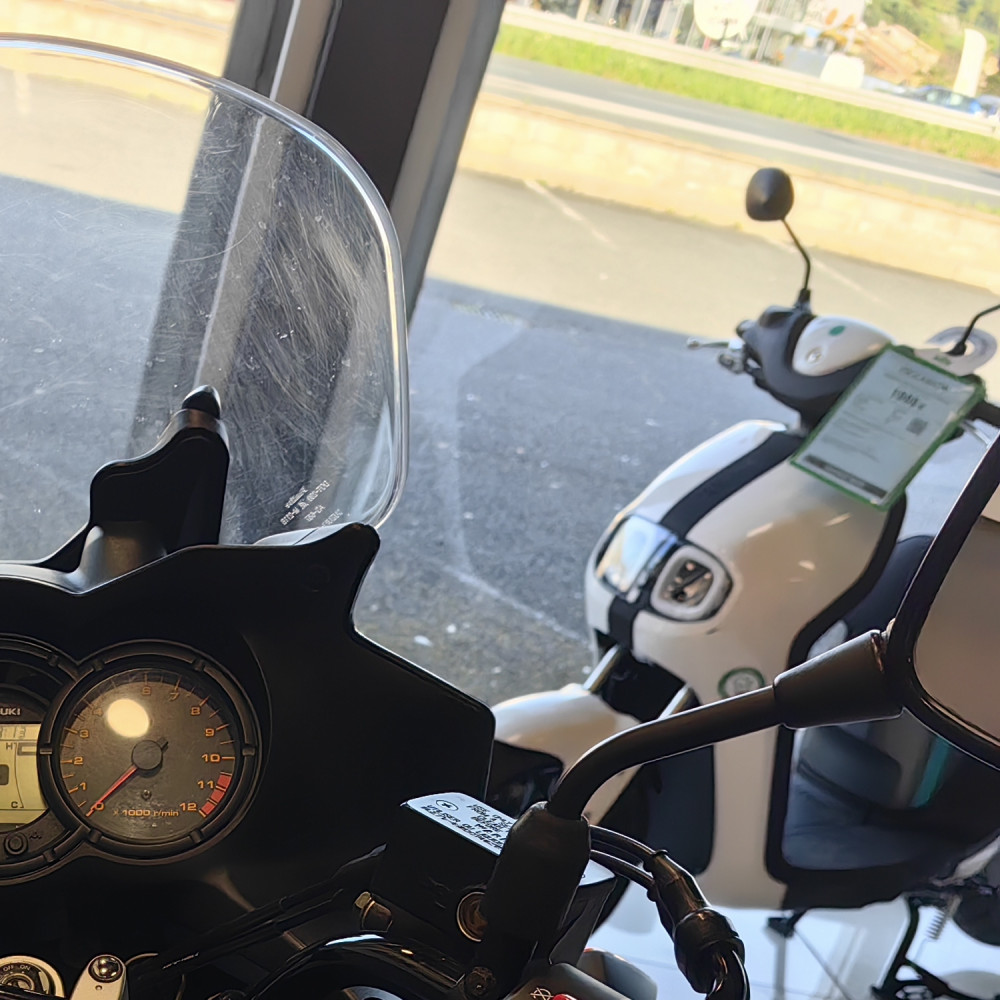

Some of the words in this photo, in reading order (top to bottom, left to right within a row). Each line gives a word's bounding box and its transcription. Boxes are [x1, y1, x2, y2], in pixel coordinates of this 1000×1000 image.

[142, 687, 151, 695] 6
[170, 692, 180, 700] 7
[190, 707, 201, 716] 8
[79, 729, 89, 738] 3
[205, 728, 215, 737] 9
[5, 742, 13, 750] H
[73, 756, 84, 765] 2
[201, 753, 221, 763] 10
[80, 782, 87, 791] 1
[197, 780, 214, 789] 11
[95, 803, 105, 811] 0
[180, 802, 197, 811] 12
[122, 809, 150, 817] 1000
[153, 809, 179, 817] r/min
